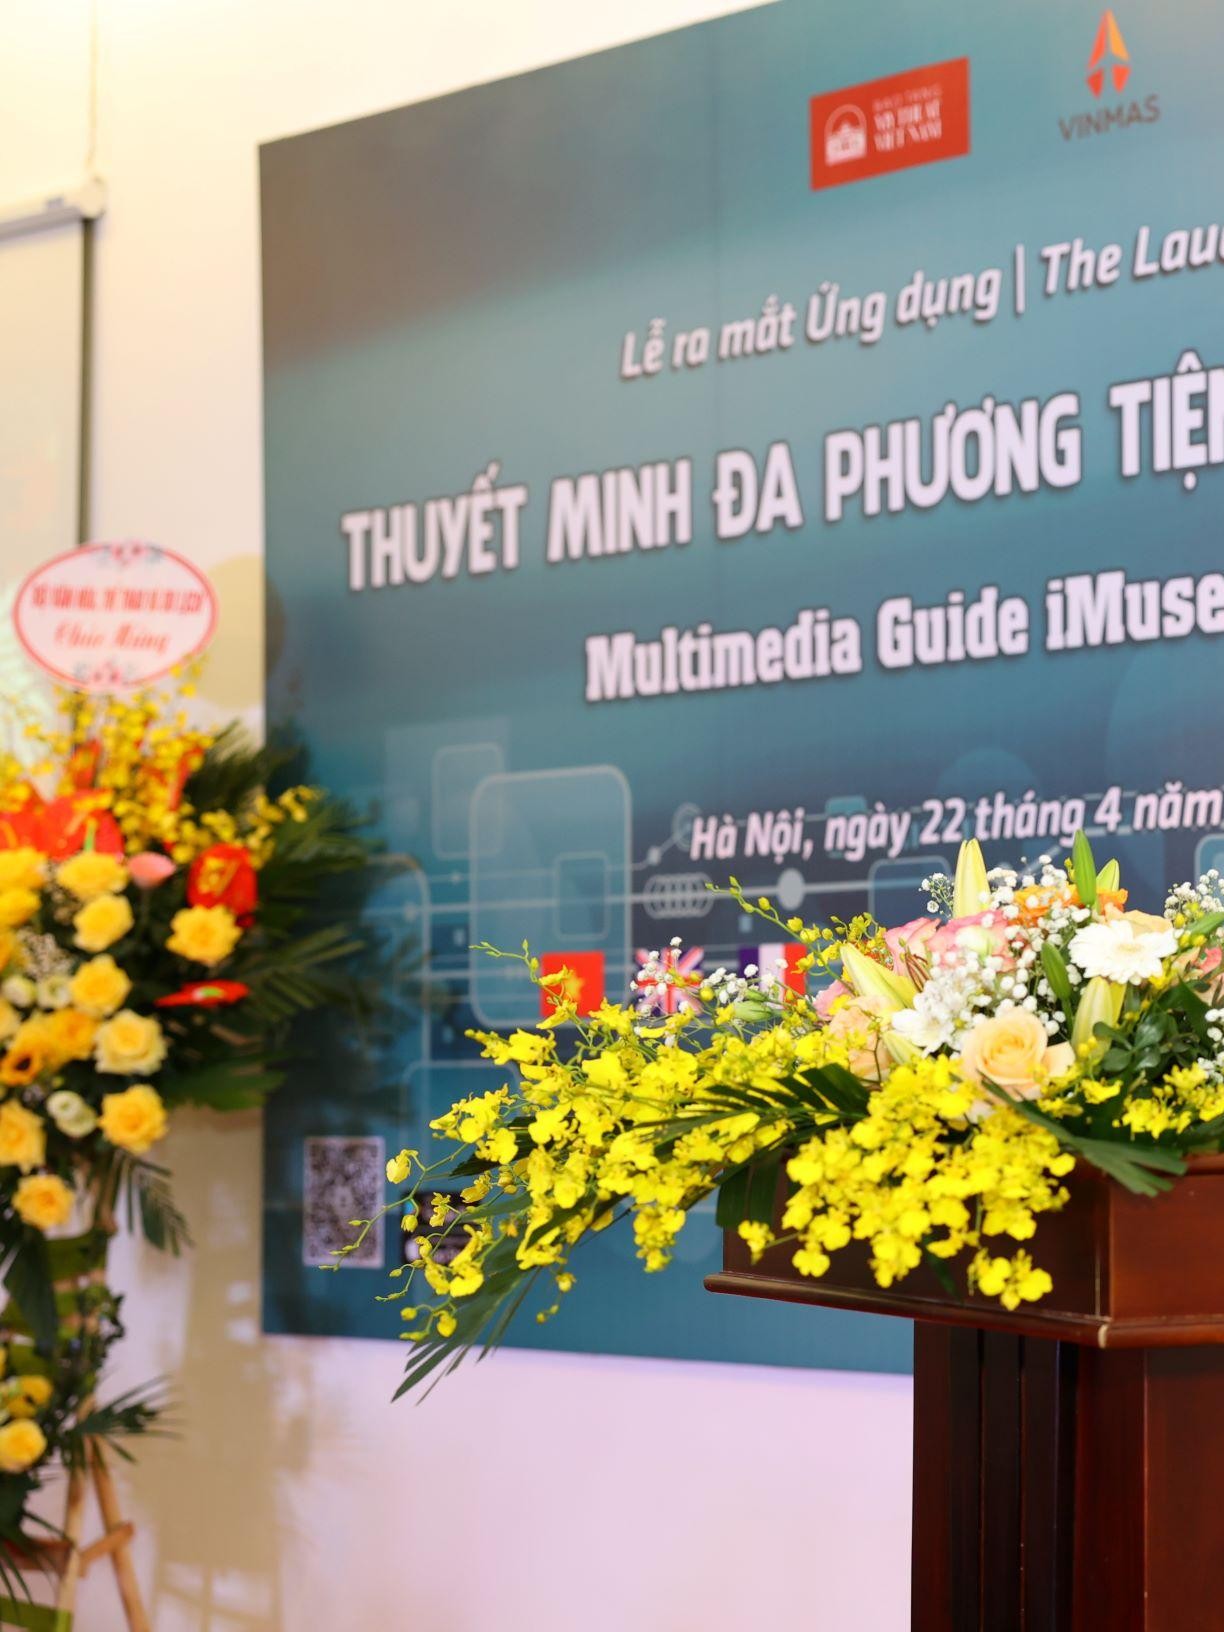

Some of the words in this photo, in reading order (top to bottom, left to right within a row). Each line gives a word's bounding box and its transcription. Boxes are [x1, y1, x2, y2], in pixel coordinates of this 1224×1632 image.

[1058, 94, 1161, 142] VINMAS
[620, 318, 666, 378] Lễ
[673, 327, 709, 367] ra
[806, 281, 887, 344] Ứng
[897, 270, 1001, 327] dụng
[1041, 238, 1121, 295] The
[341, 462, 527, 591] THUYẾT
[547, 459, 692, 563] MINH
[713, 442, 803, 538] ĐA
[825, 393, 1082, 521] PHƯƠNG
[586, 608, 862, 701] Multimedia
[877, 586, 1028, 668] Guide
[690, 814, 738, 860] Hà
[744, 807, 813, 864] Nội,
[824, 801, 911, 861] ngày
[919, 797, 966, 845] 22
[975, 790, 1086, 848] tháng
[1094, 786, 1122, 832] 4
[1133, 781, 1223, 830] năm
